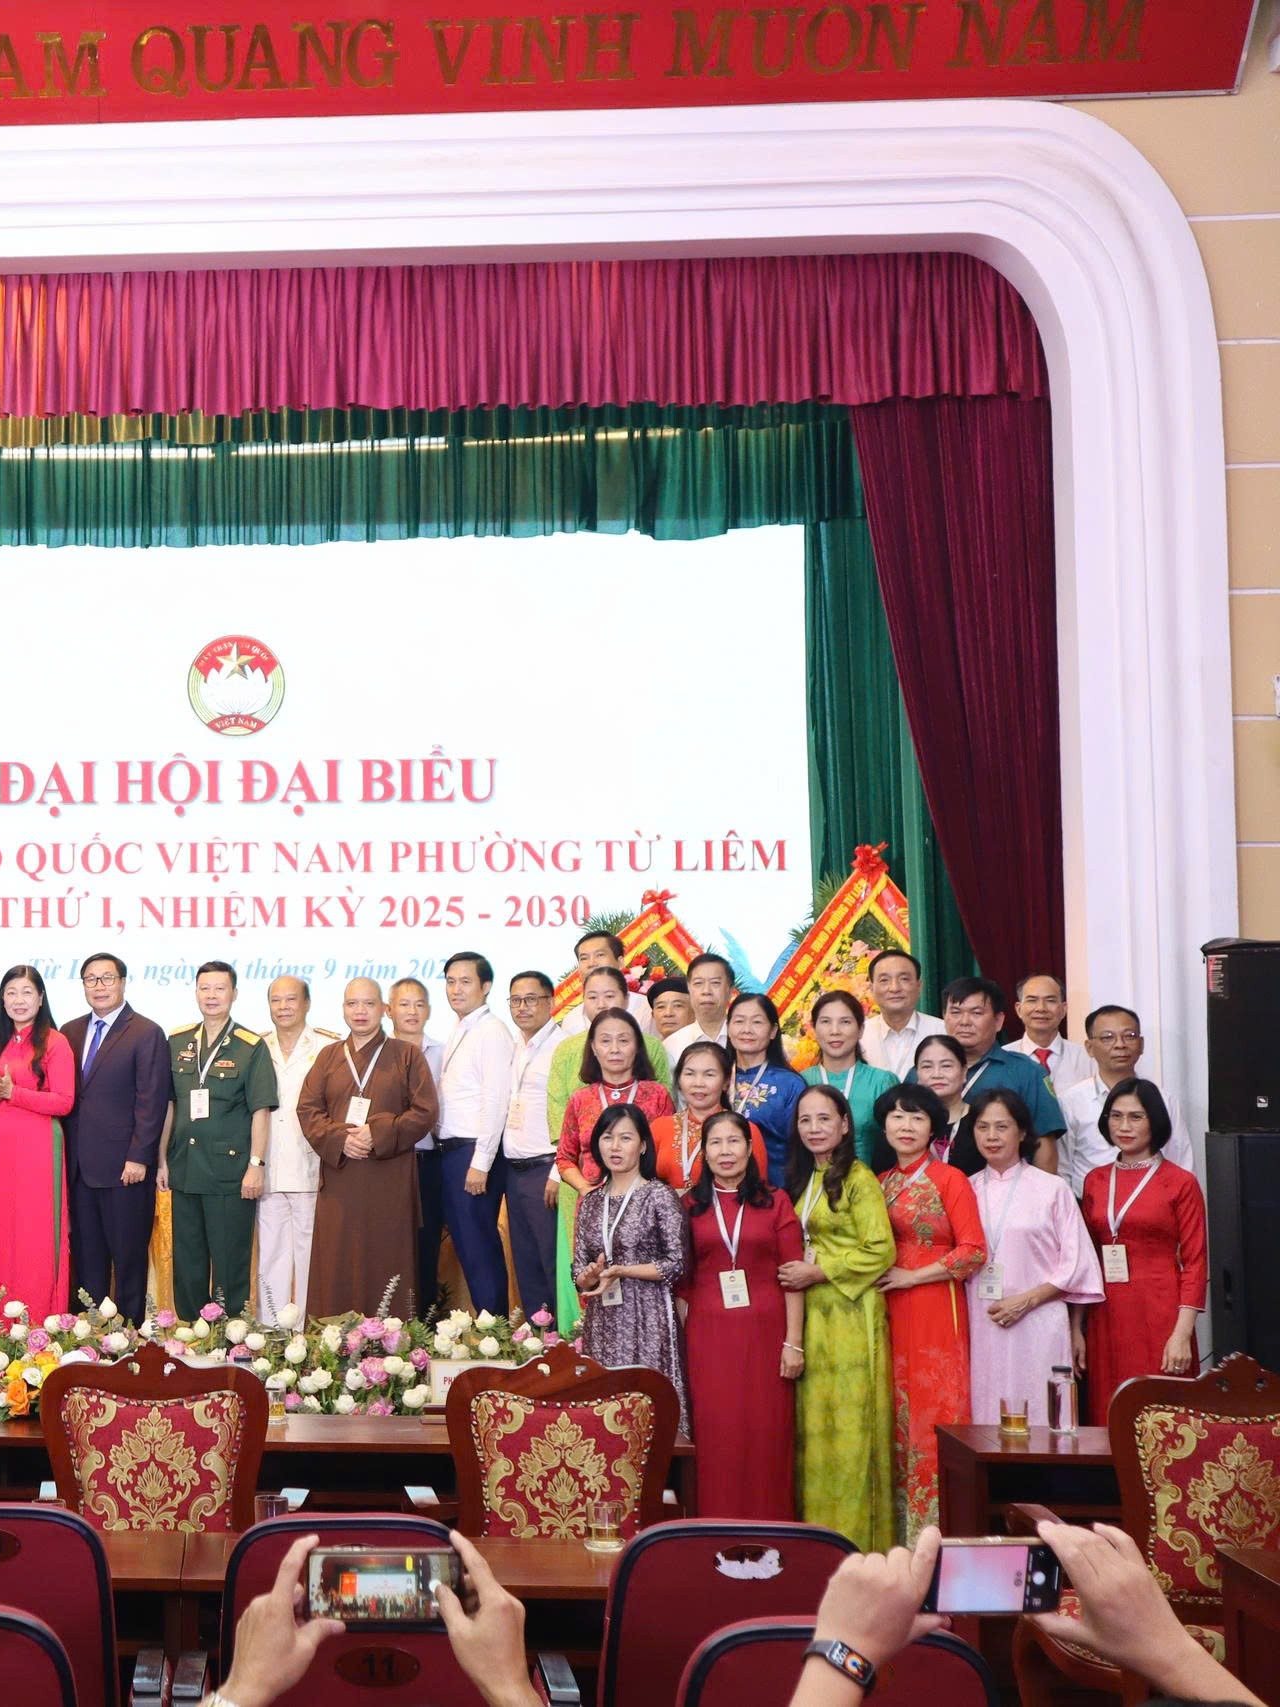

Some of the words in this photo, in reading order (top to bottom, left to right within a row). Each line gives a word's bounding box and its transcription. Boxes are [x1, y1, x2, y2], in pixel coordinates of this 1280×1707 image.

[131, 19, 401, 97] QUANG
[426, 12, 641, 87] VINH
[116, 752, 225, 818] HỘI
[238, 758, 344, 817] ĐẠI
[358, 744, 497, 804] BIỂU
[15, 832, 144, 882] QUỐC
[154, 836, 259, 883] VIỆT
[273, 841, 373, 874] NAM
[389, 830, 583, 874] PHƯỜNG
[595, 830, 662, 873] TỪ
[673, 830, 789, 873] LIÊM
[99, 896, 127, 936] I,
[138, 890, 288, 938] NHIỆM
[303, 886, 366, 929] KỲ
[379, 895, 465, 929] 2025
[477, 912, 492, 920] -
[504, 895, 591, 929] 2030
[28, 957, 63, 980] Từ
[143, 957, 200, 986] ngày
[245, 957, 316, 986] tháng
[324, 958, 338, 980] 9
[344, 957, 398, 980] năm
[407, 958, 448, 980] 202
[361, 1652, 396, 1681] 11
